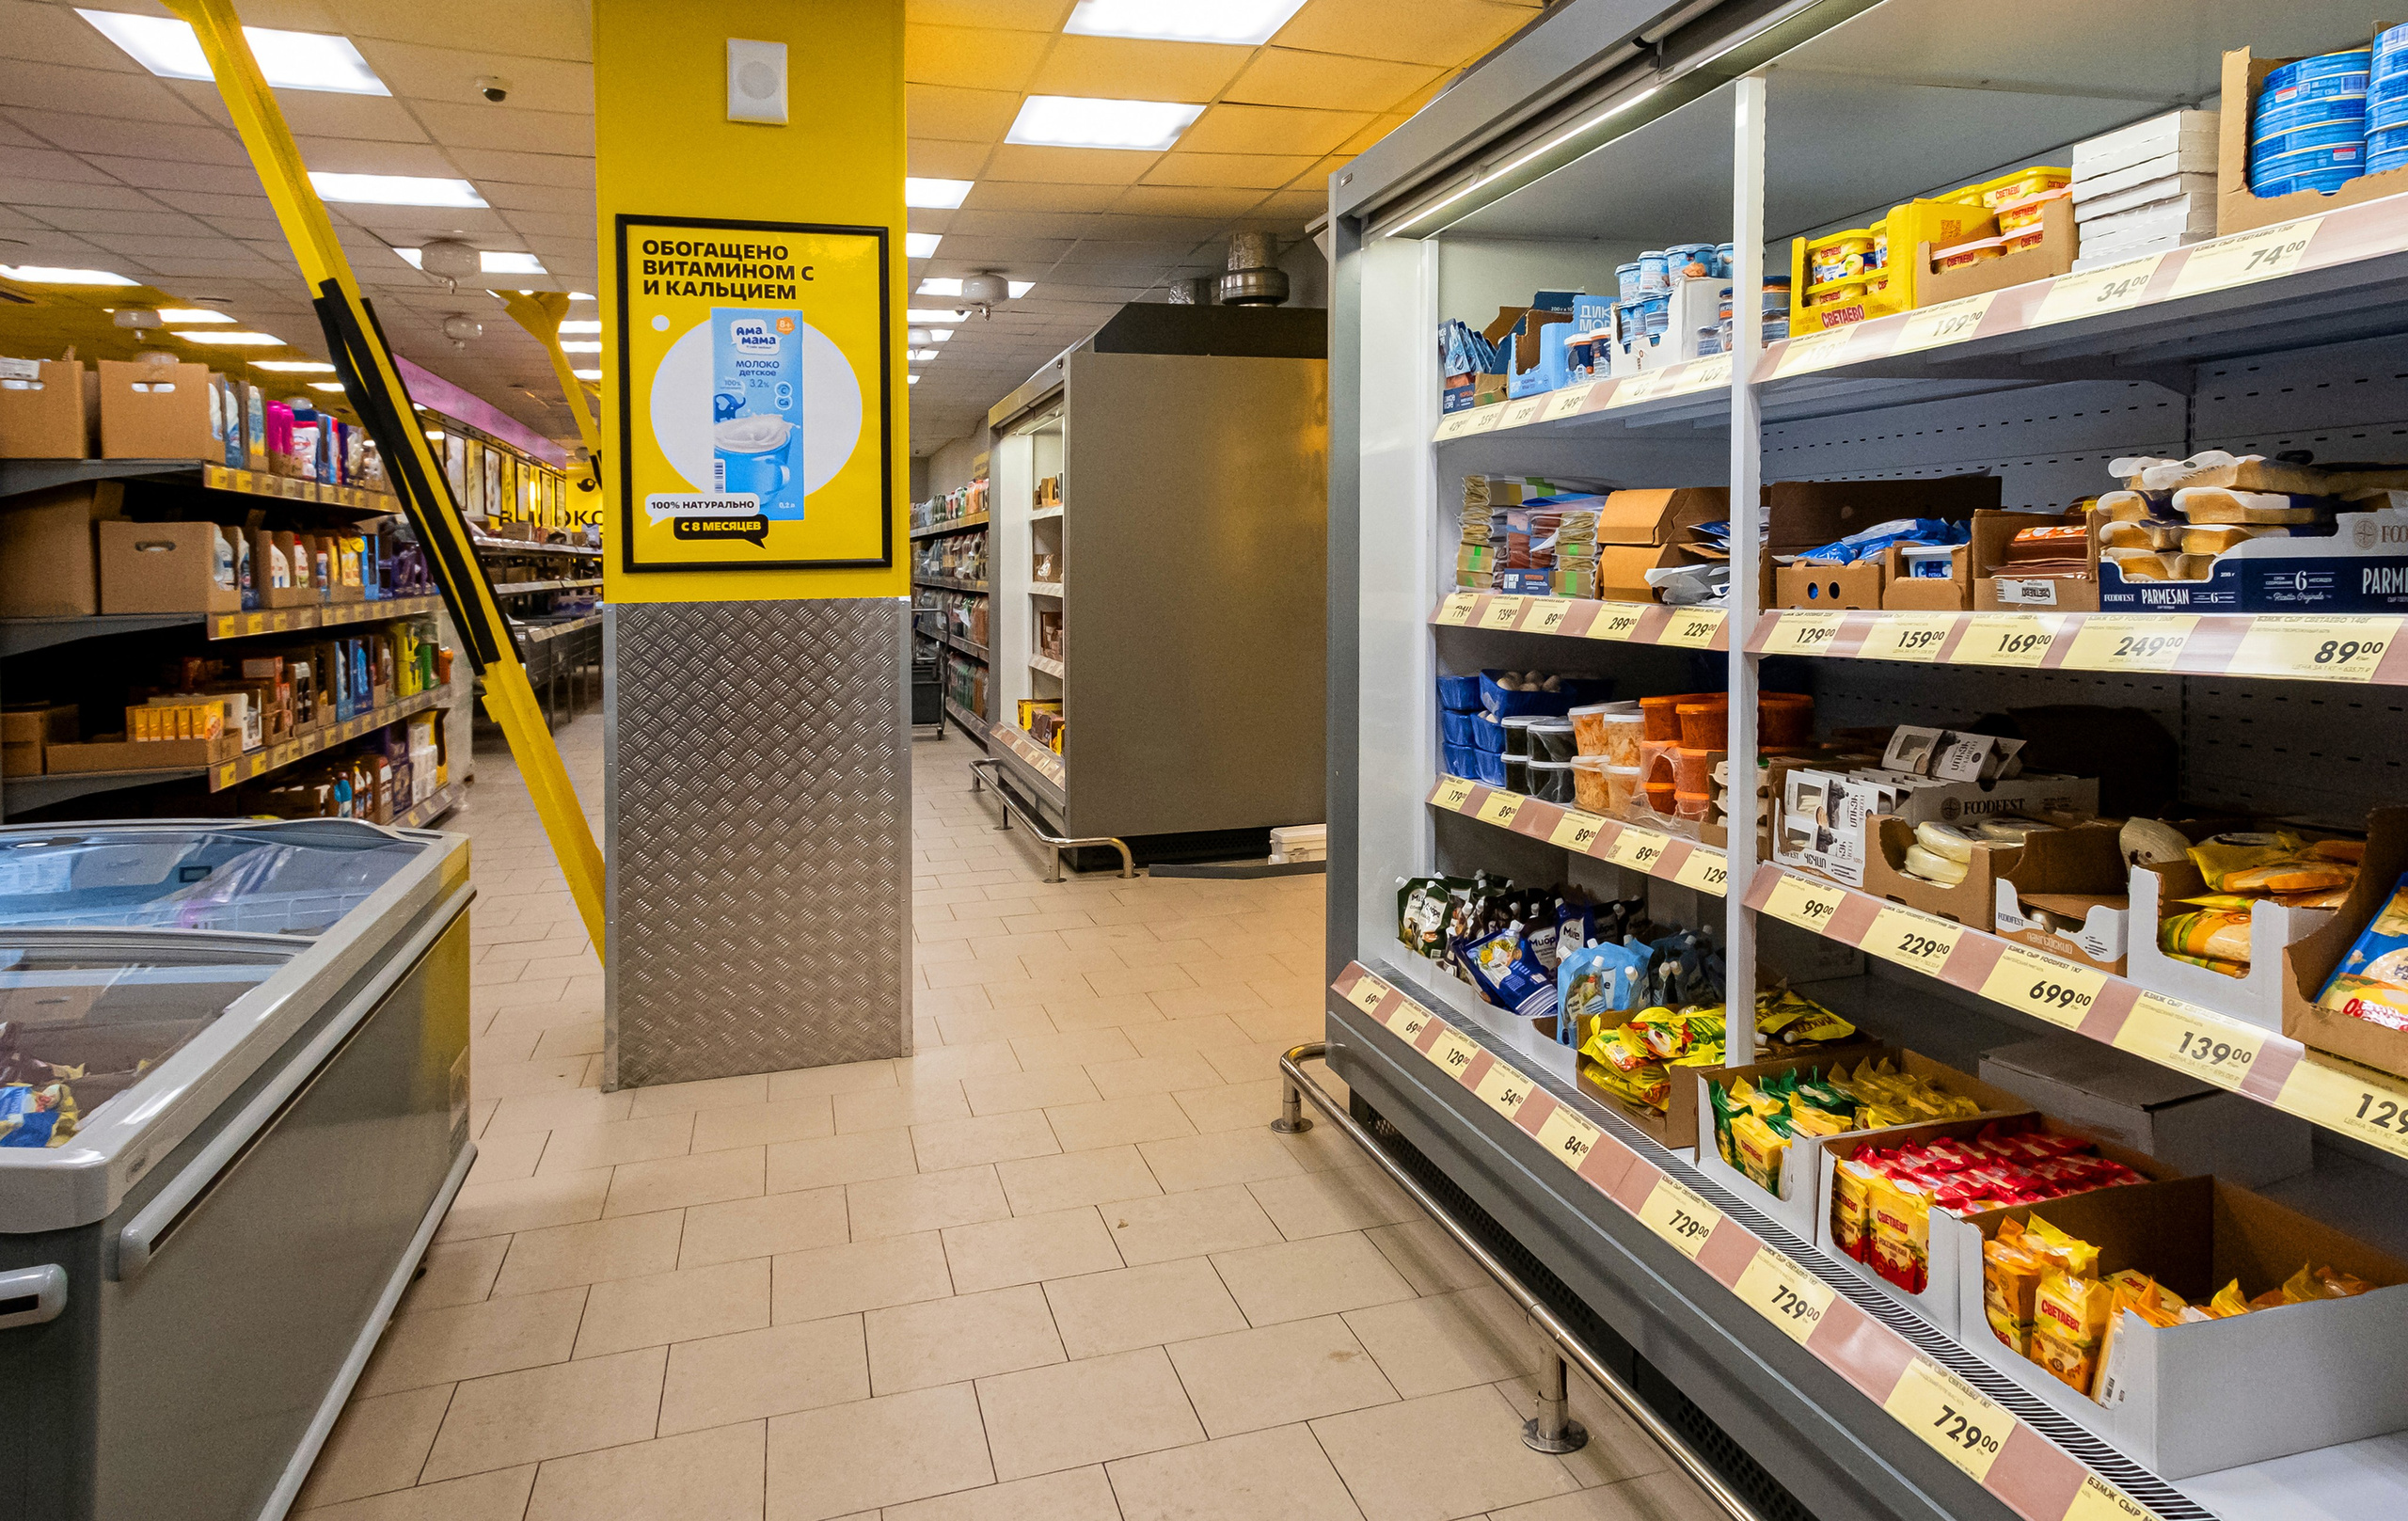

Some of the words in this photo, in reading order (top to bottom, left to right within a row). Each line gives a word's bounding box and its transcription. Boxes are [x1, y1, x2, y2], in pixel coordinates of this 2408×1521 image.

[642, 240, 789, 263] ОБОГАЩЕНО
[642, 260, 795, 281] ВИТАМИНОМ
[800, 265, 815, 281] С
[642, 280, 660, 295] И
[666, 281, 797, 301] КАЛЬЦИЕМ
[1821, 305, 1866, 328] СВЕТАЕВО
[650, 501, 680, 510] 100%
[682, 500, 755, 510] НАТУРАЛЬНО
[681, 521, 690, 531] С
[691, 521, 700, 531] 8
[702, 521, 762, 533] МЕСЯЦЕВ
[2295, 570, 2307, 591] 6
[2103, 594, 2135, 602] FOODFEST
[2141, 588, 2190, 605] PARMESAN
[1797, 627, 1825, 643] 129
[1897, 630, 1933, 648] 159
[1998, 633, 2037, 653] 169
[2113, 636, 2166, 658] 249
[2314, 640, 2360, 664] 89
[1964, 798, 2026, 816] FOODFEST
[1802, 899, 1824, 918] 99
[1897, 932, 1937, 958] 229
[2029, 979, 2076, 1008] 699
[2178, 1030, 2231, 1065] 139
[1668, 1209, 1700, 1238] 729
[1771, 1284, 1808, 1320] 729
[1933, 1404, 1982, 1450] 729
[2086, 1476, 2117, 1502] БЗМЖ
[2118, 1498, 2142, 1517] СЫР
